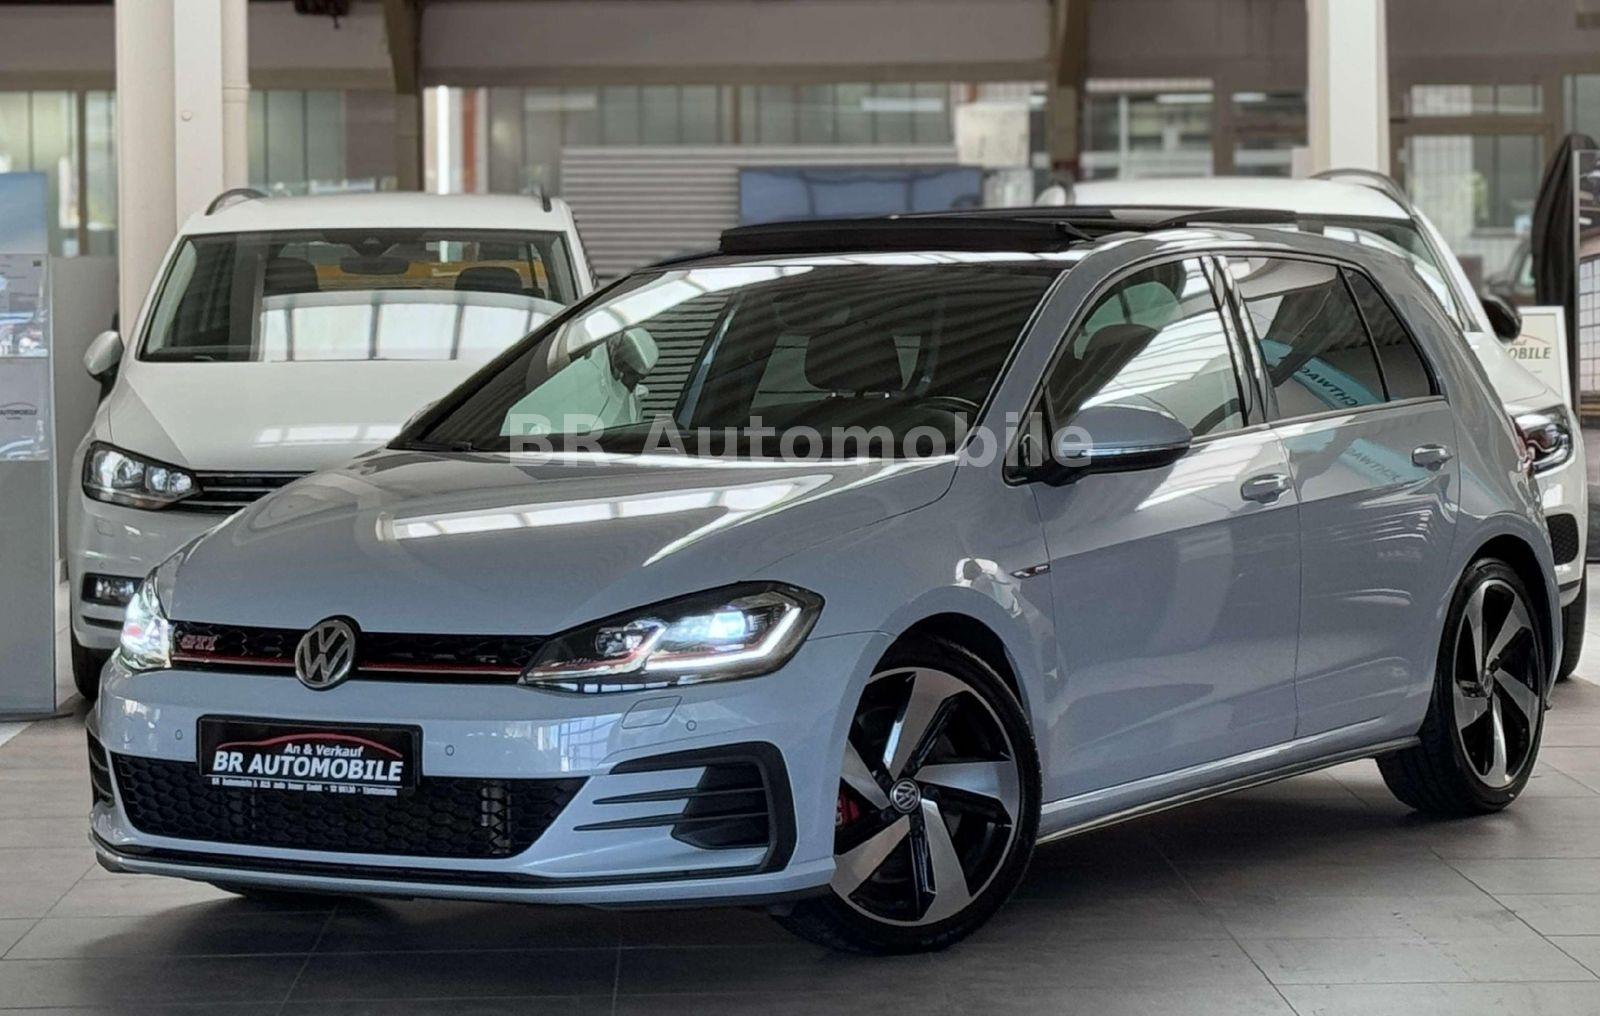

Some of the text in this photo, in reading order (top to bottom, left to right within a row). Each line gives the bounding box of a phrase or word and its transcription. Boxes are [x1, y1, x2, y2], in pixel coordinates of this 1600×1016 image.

[284, 743, 364, 758] An & Verkauf
[213, 750, 404, 781] BR AUTOMOBILE
